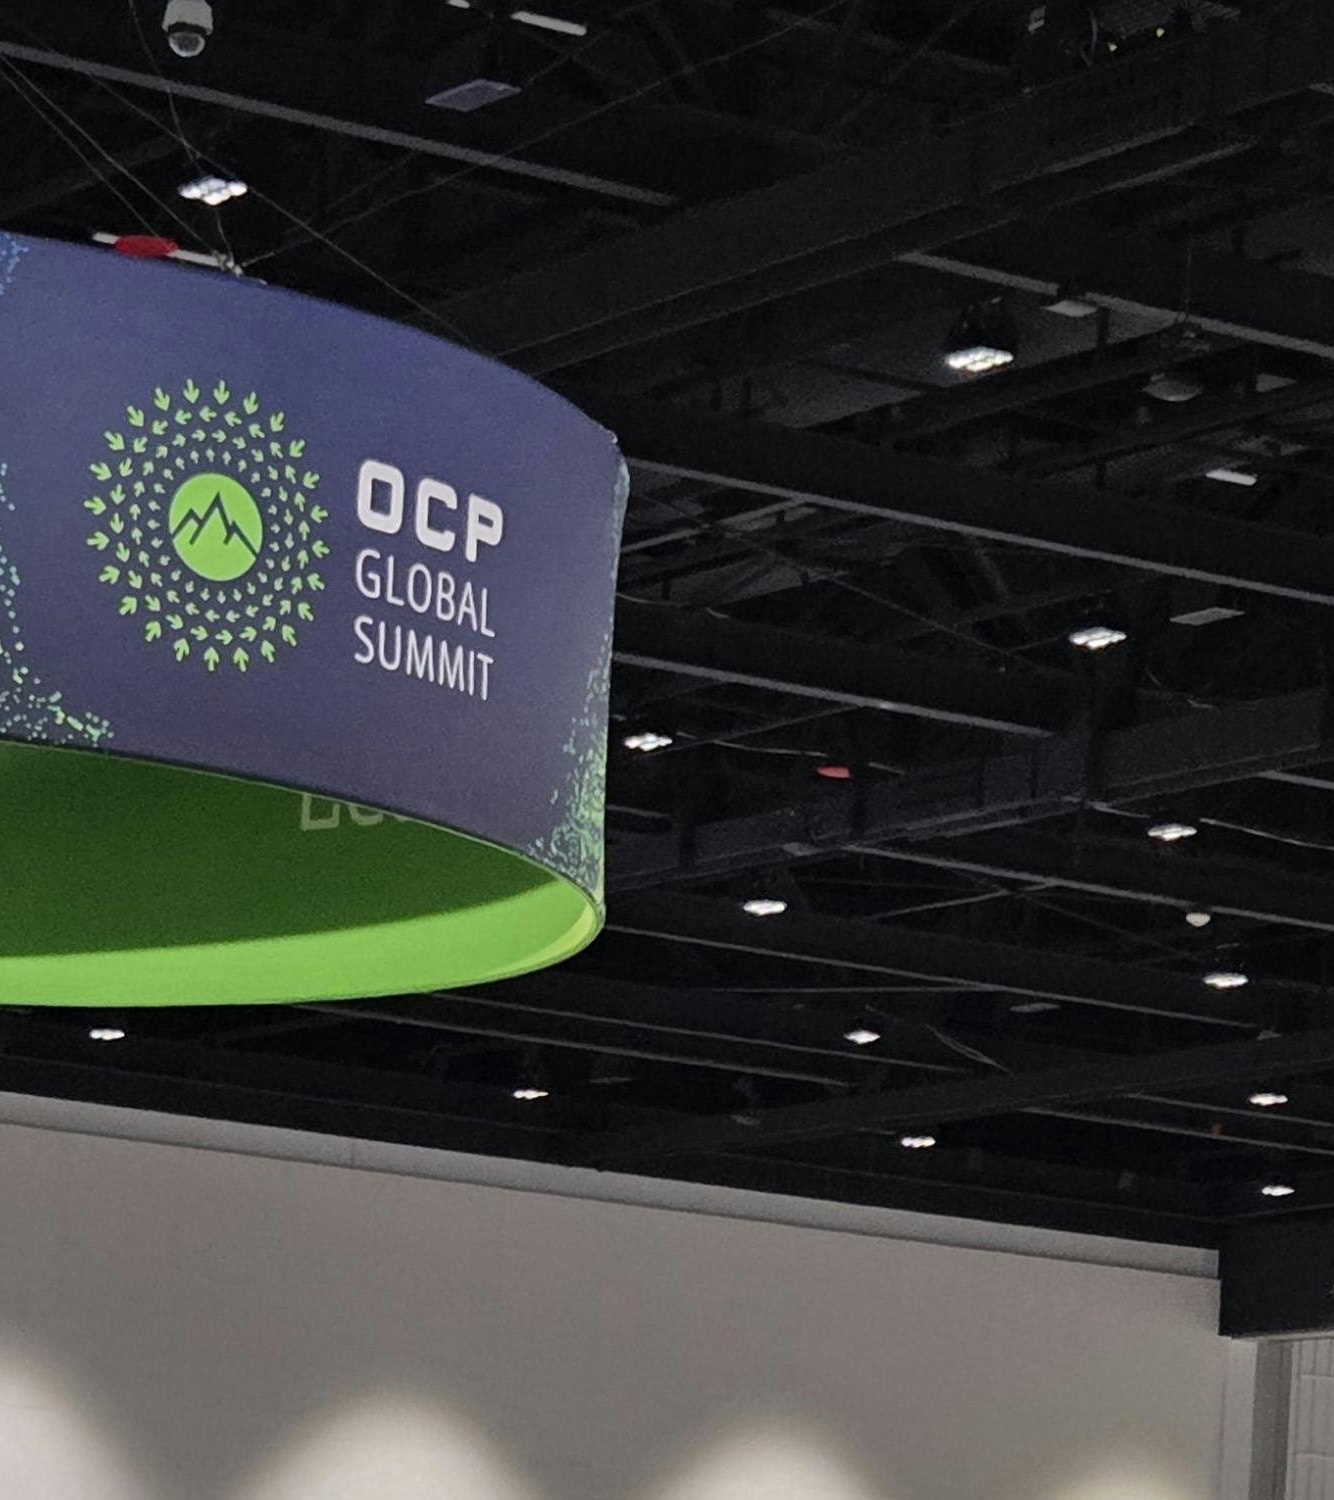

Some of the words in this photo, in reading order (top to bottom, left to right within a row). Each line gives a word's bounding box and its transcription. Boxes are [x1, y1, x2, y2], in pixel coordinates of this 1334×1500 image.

[357, 459, 504, 562] OCP
[356, 548, 496, 638] GLOBAL
[353, 615, 495, 700] SUMMIT
